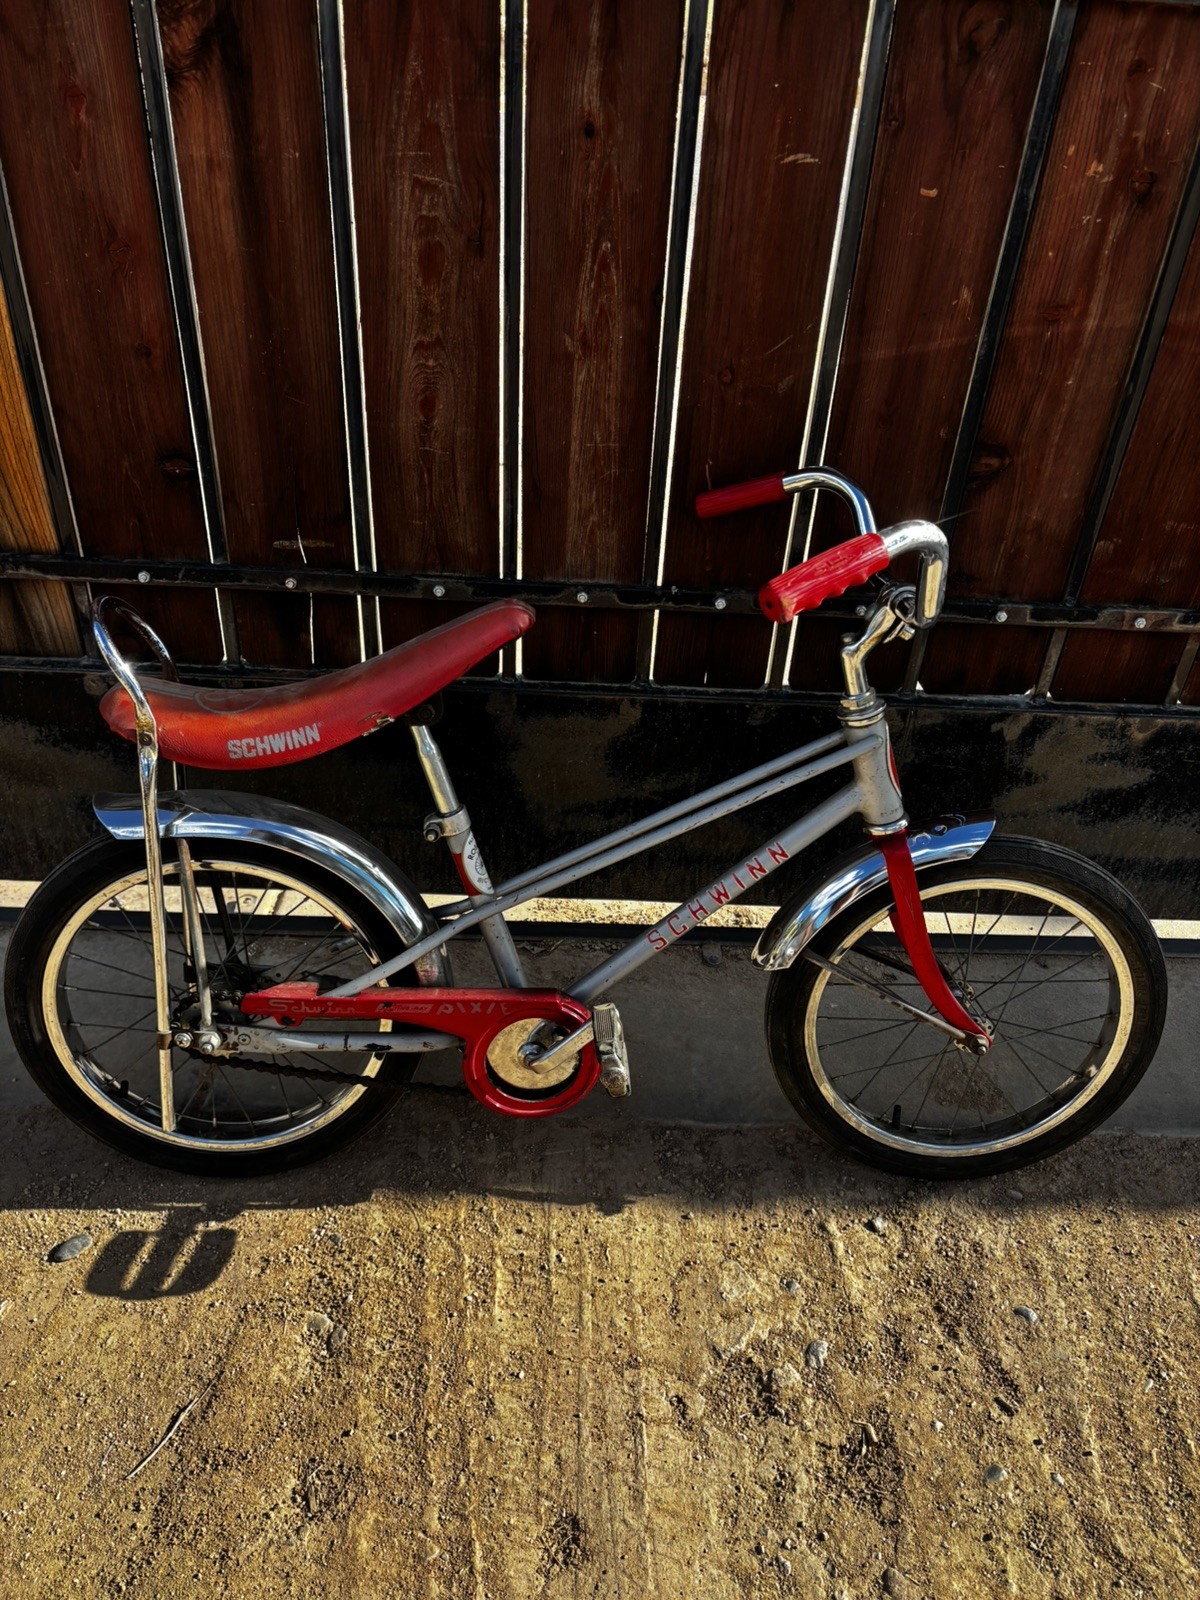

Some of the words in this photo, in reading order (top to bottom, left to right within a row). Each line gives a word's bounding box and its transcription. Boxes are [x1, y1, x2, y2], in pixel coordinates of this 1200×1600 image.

[227, 722, 320, 759] SCHWINN
[646, 841, 789, 952] SCHWINN
[256, 999, 366, 1014] Schwinn
[435, 1002, 512, 1016] PIXIE
